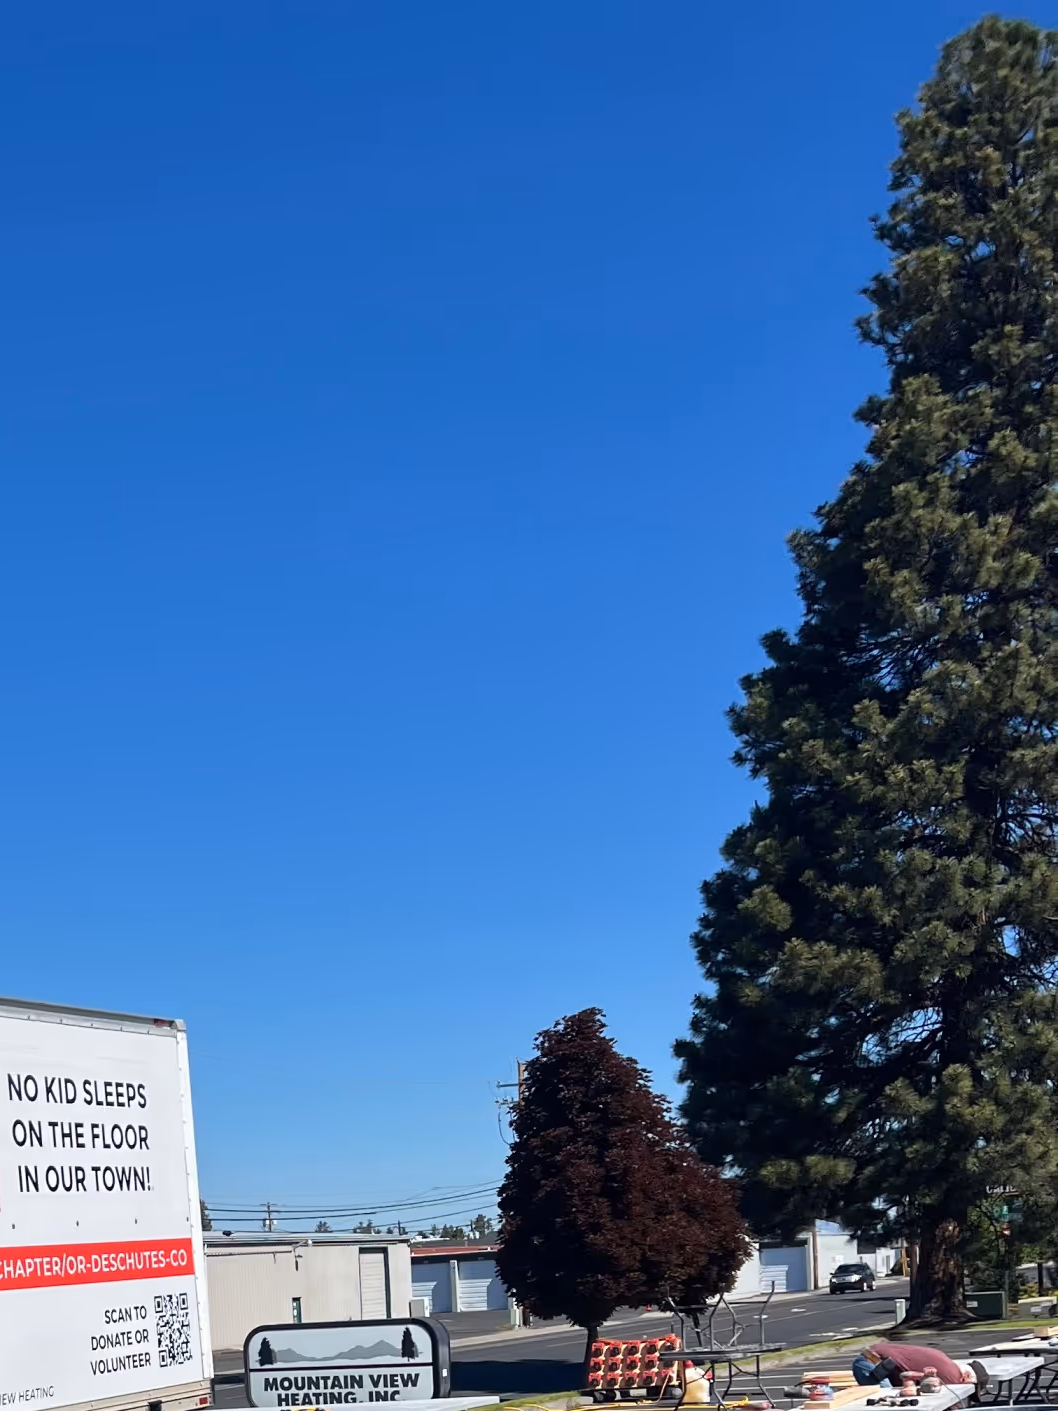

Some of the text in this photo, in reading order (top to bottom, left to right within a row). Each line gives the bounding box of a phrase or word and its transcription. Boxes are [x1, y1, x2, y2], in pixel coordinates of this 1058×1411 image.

[7, 1073, 147, 1109] NO KID SLEEPS
[12, 1119, 150, 1150] ON THE FLOOR
[18, 1165, 151, 1193] IN OUR TOWN!
[104, 1305, 147, 1324] SCAN TO
[91, 1329, 149, 1351] DONATE OR
[90, 1352, 151, 1376] VOLUNTEER
[19, 1385, 54, 1401] HEATING
[264, 1373, 420, 1391] MOUNTAIN VIEW
[368, 1390, 405, 1402] INC
